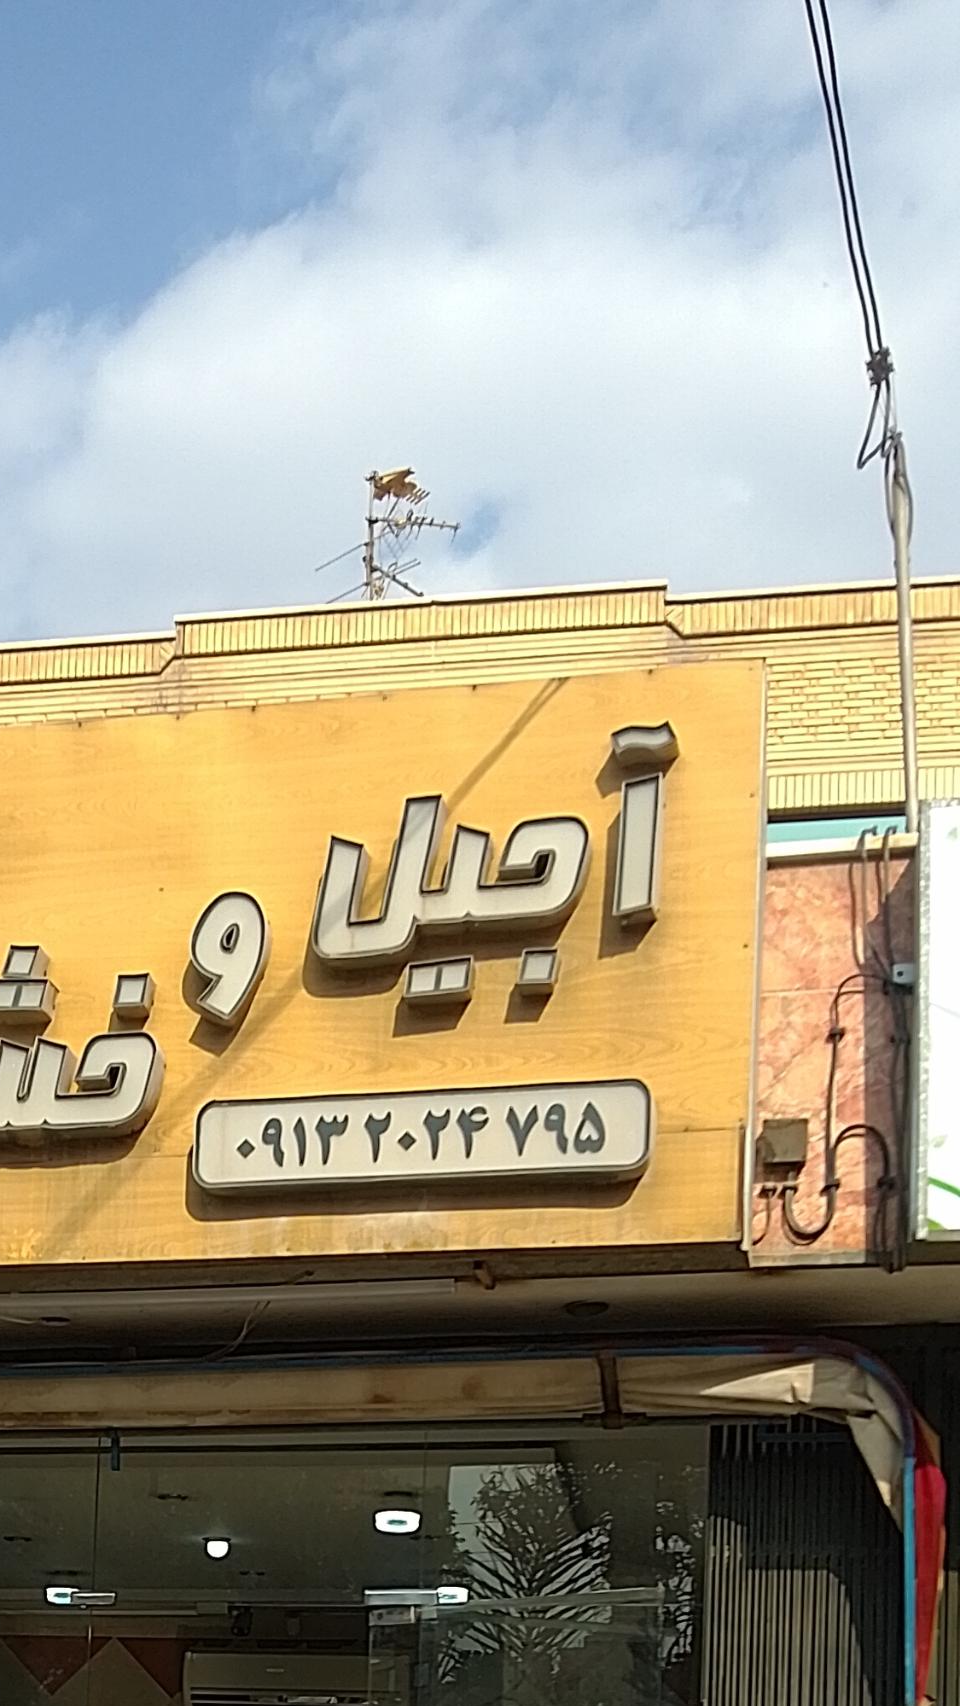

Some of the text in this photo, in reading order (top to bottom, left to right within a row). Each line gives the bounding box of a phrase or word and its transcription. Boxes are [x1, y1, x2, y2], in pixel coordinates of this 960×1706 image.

[312, 722, 677, 1000] آجیل
[190, 891, 270, 1026] و
[239, 1101, 605, 1168] ۰۹۱۳ ۲۰۲۴ ۷۹۵
